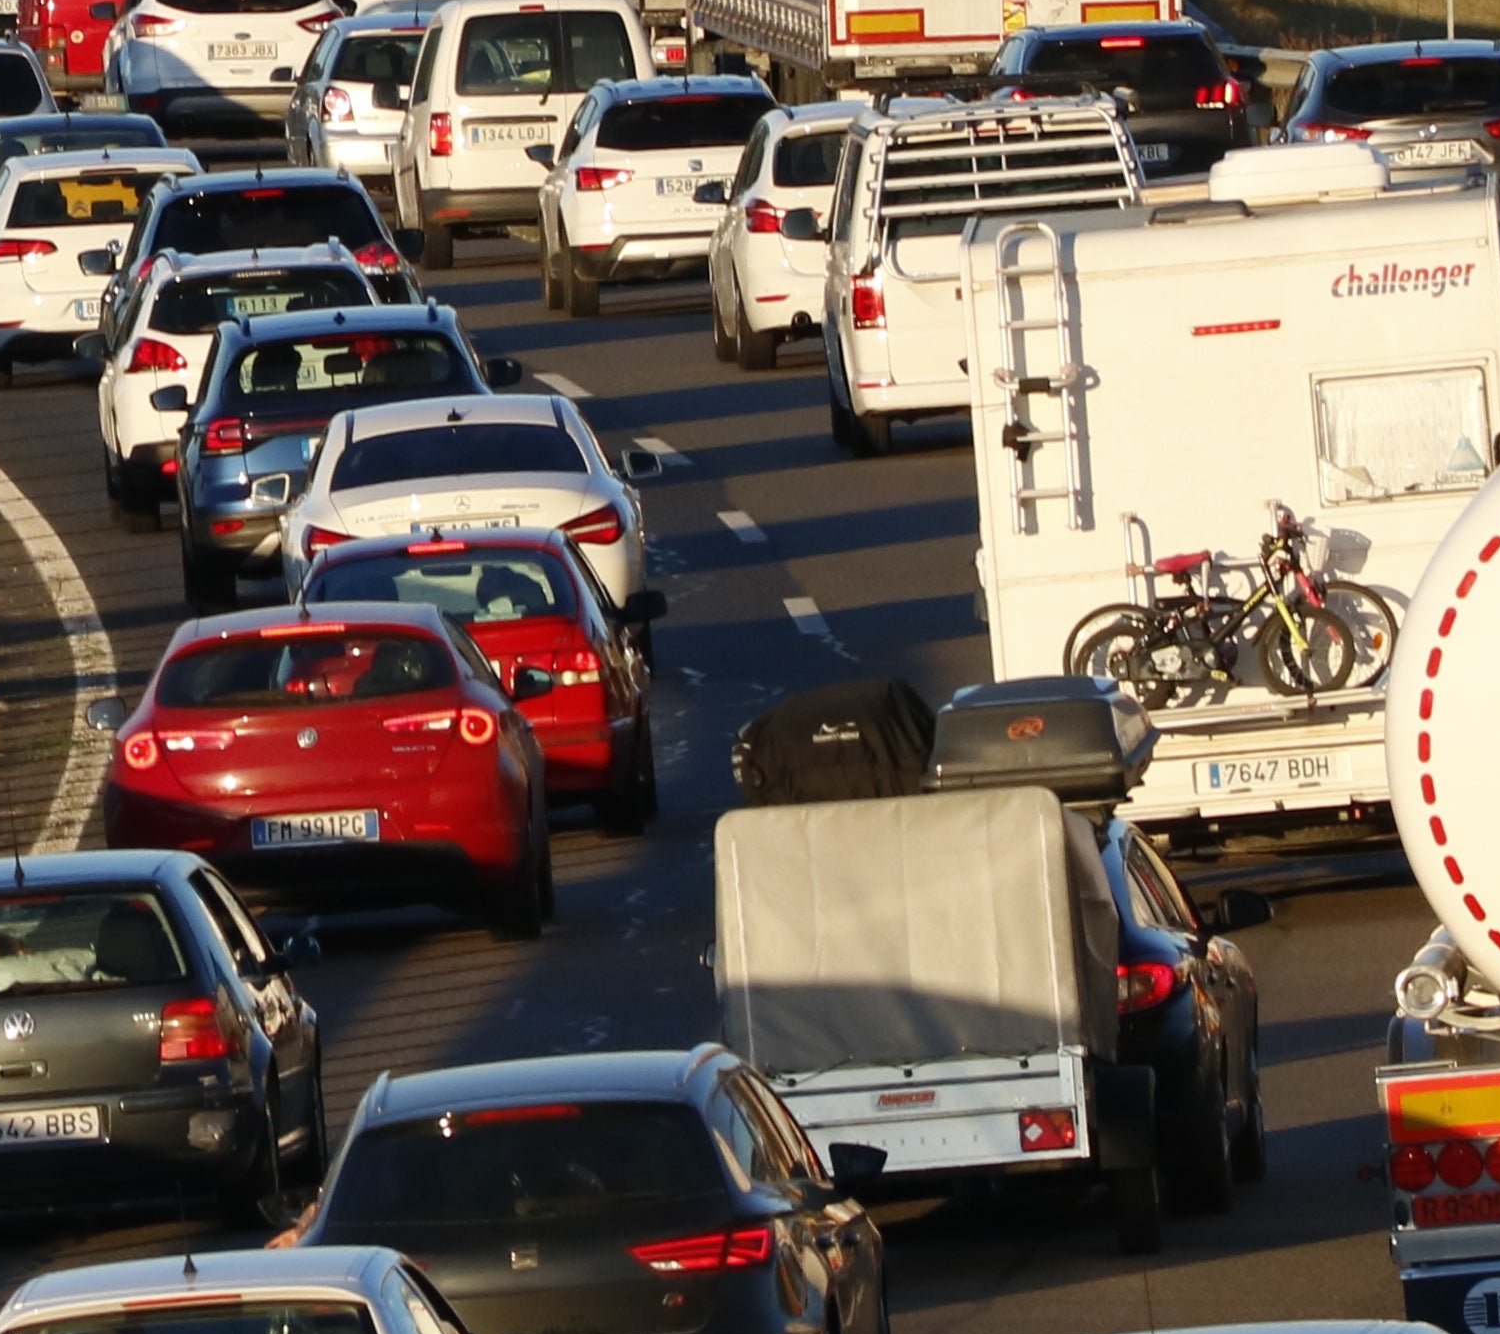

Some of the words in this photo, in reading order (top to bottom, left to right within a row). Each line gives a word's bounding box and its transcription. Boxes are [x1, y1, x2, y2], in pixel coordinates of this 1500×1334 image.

[481, 127, 513, 141] 1344
[1225, 759, 1279, 784] 7647
[1289, 756, 1330, 779] BDH
[45, 1111, 94, 1136] BBS
